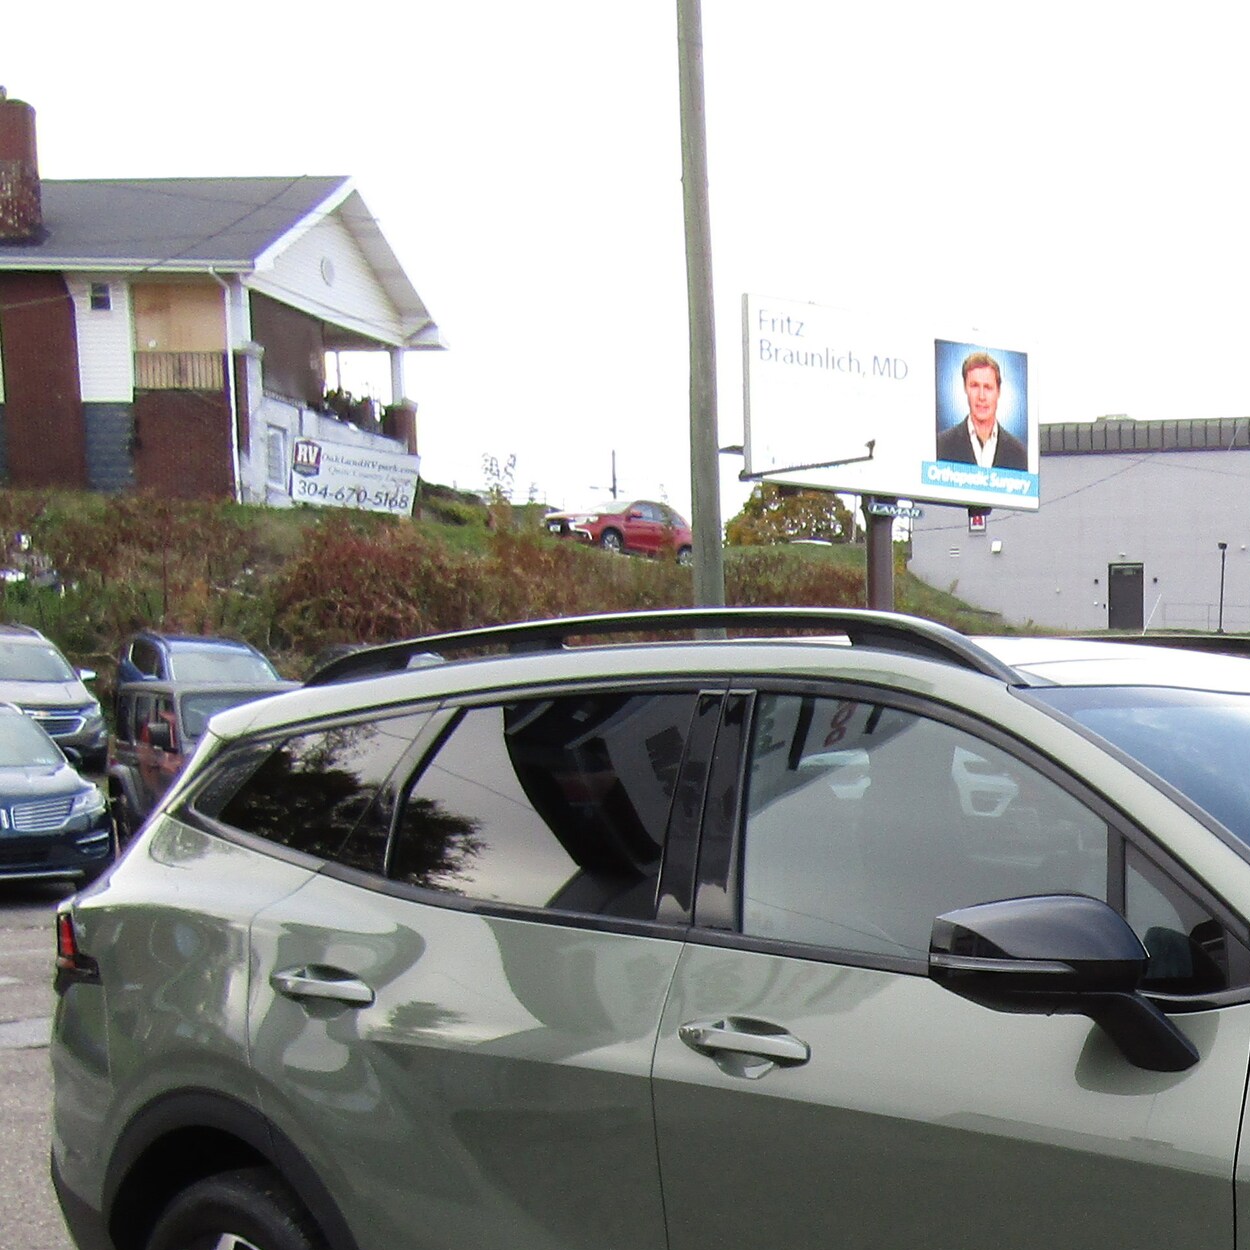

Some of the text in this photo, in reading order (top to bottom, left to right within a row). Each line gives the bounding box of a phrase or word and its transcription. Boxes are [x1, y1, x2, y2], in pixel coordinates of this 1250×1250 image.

[759, 309, 804, 337] Fritz
[760, 338, 908, 380] Braunlich, MD
[297, 444, 318, 463] RV
[927, 465, 1032, 494] Orthopedic Surgery
[298, 480, 410, 509] 304-670-5168
[872, 504, 920, 517] LAMAR
